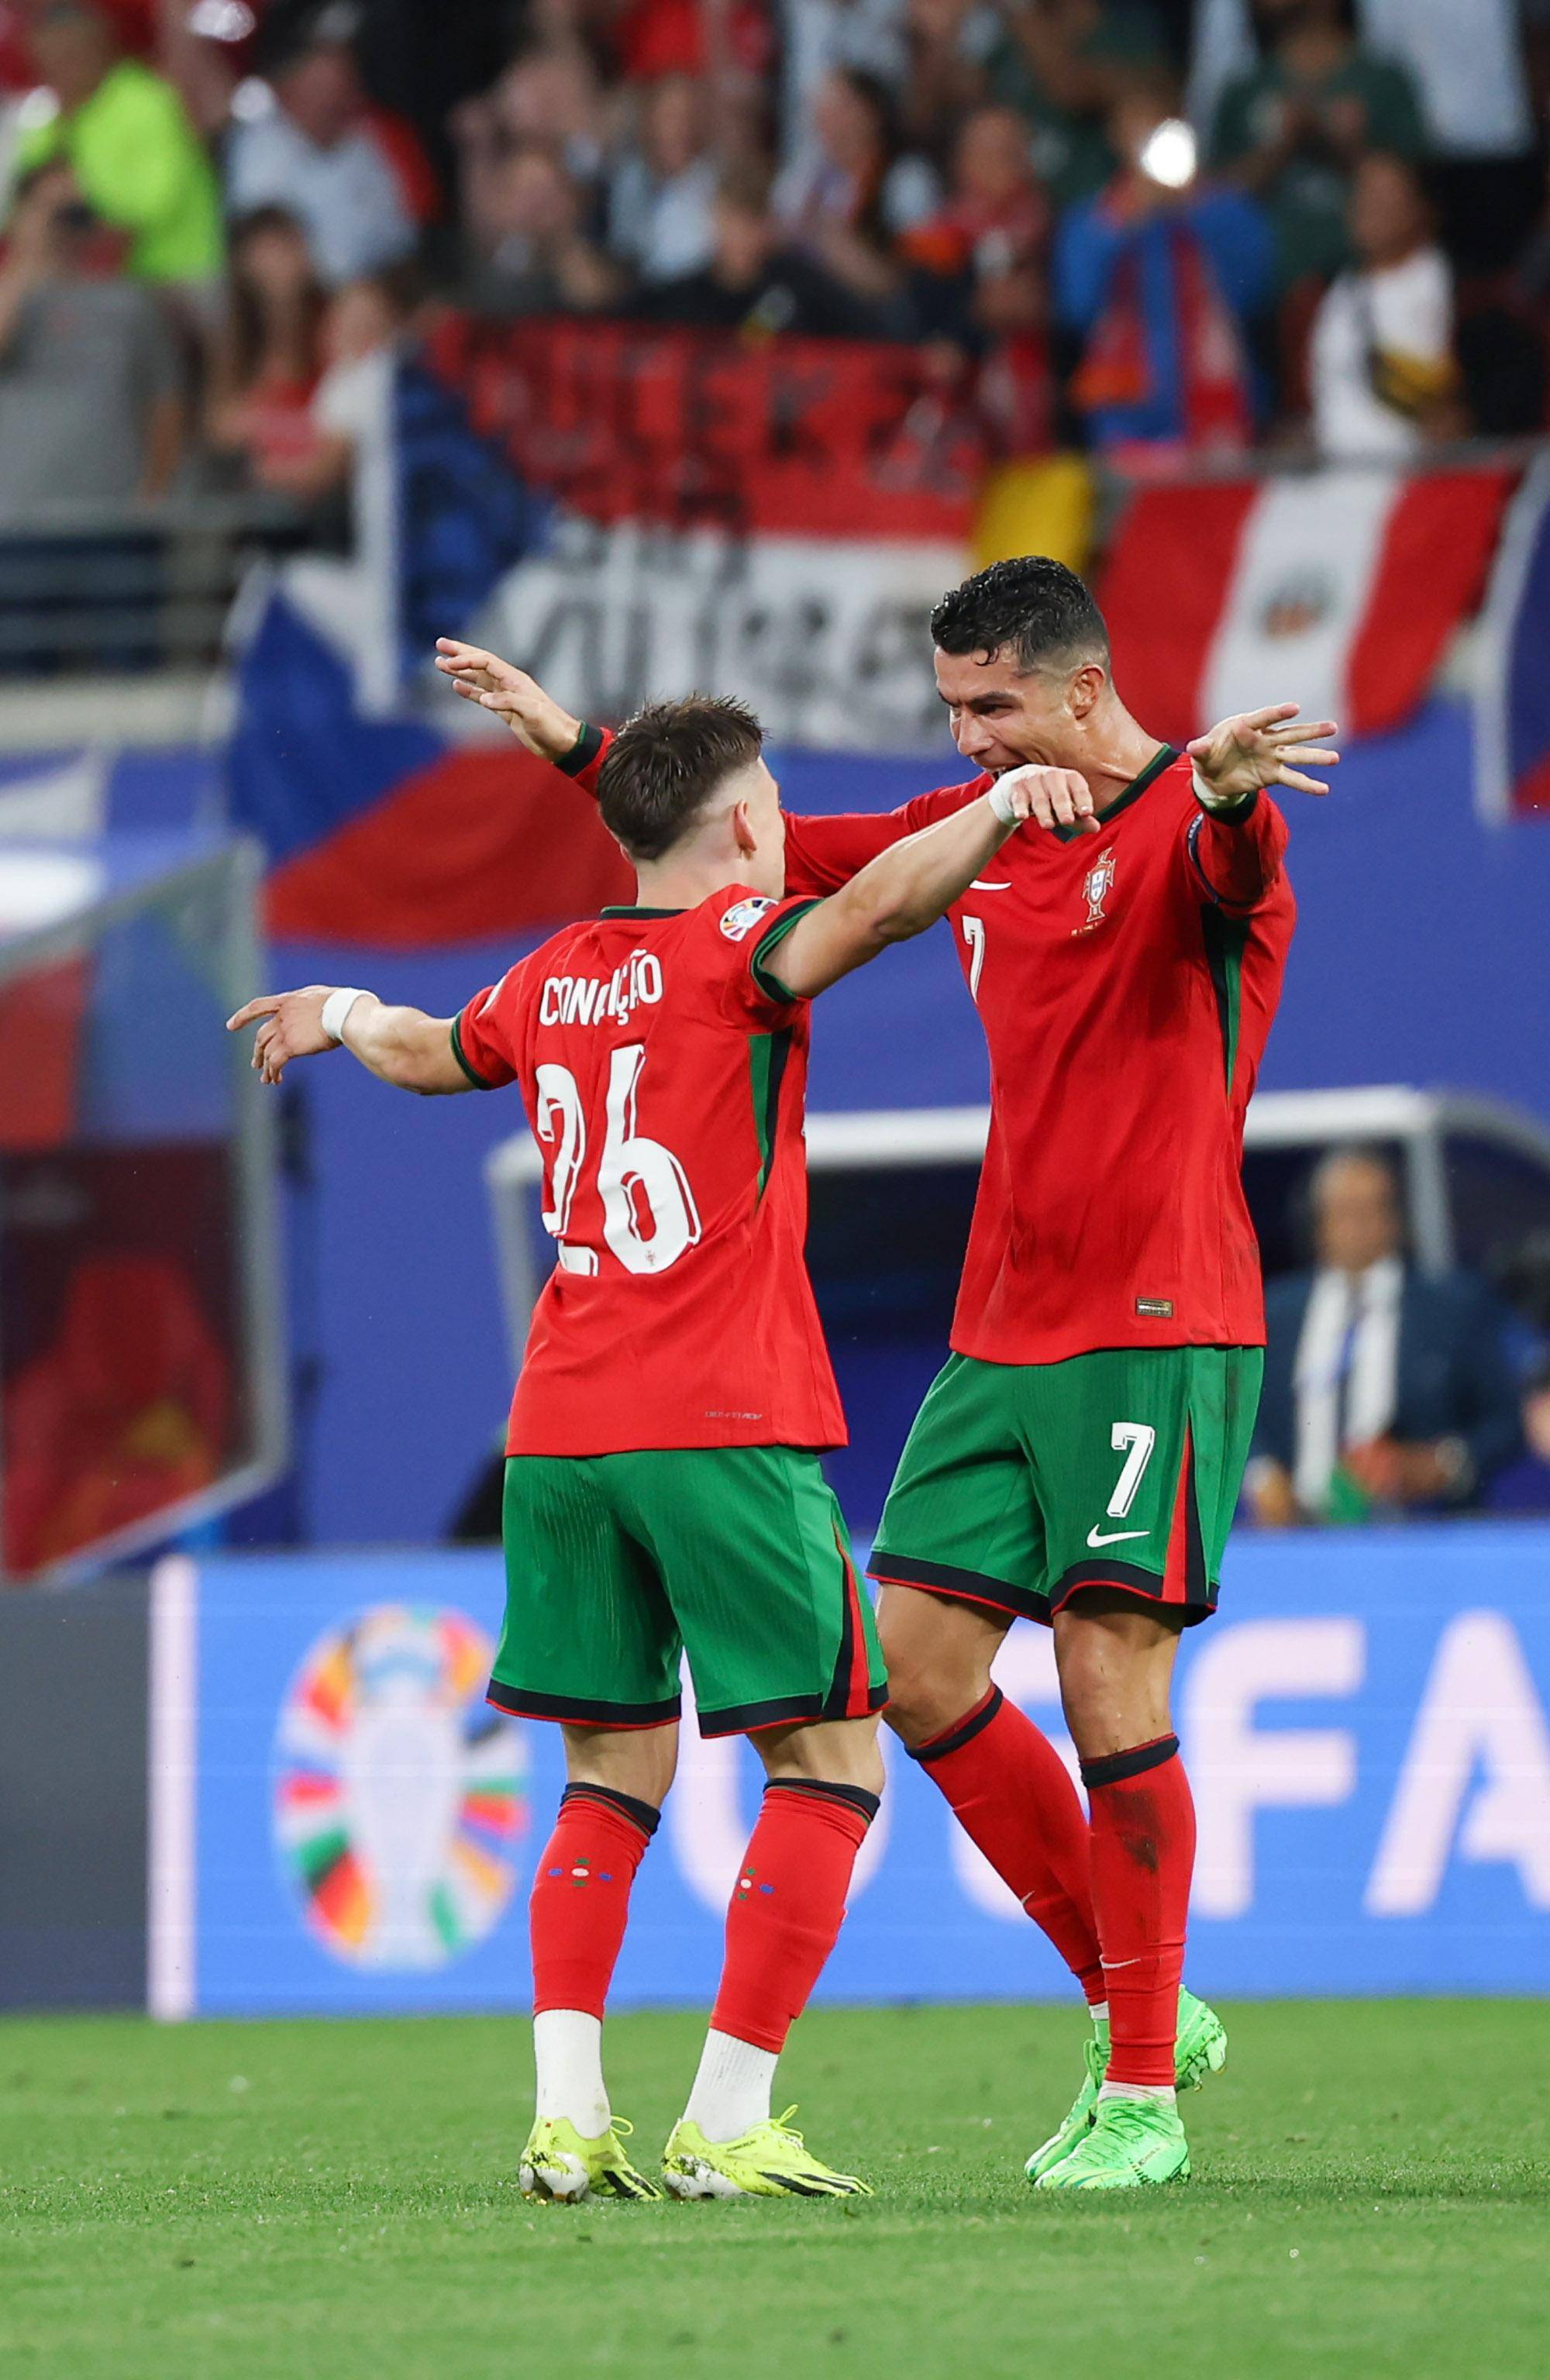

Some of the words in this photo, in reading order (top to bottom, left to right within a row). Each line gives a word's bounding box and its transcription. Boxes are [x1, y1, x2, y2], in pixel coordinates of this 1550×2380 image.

[539, 949, 663, 1026] CONIÇÃO
[961, 915, 985, 1004] 7
[536, 1044, 702, 1277] 26
[1106, 1421, 1156, 1518] 7
[671, 1610, 1550, 1920] FA
